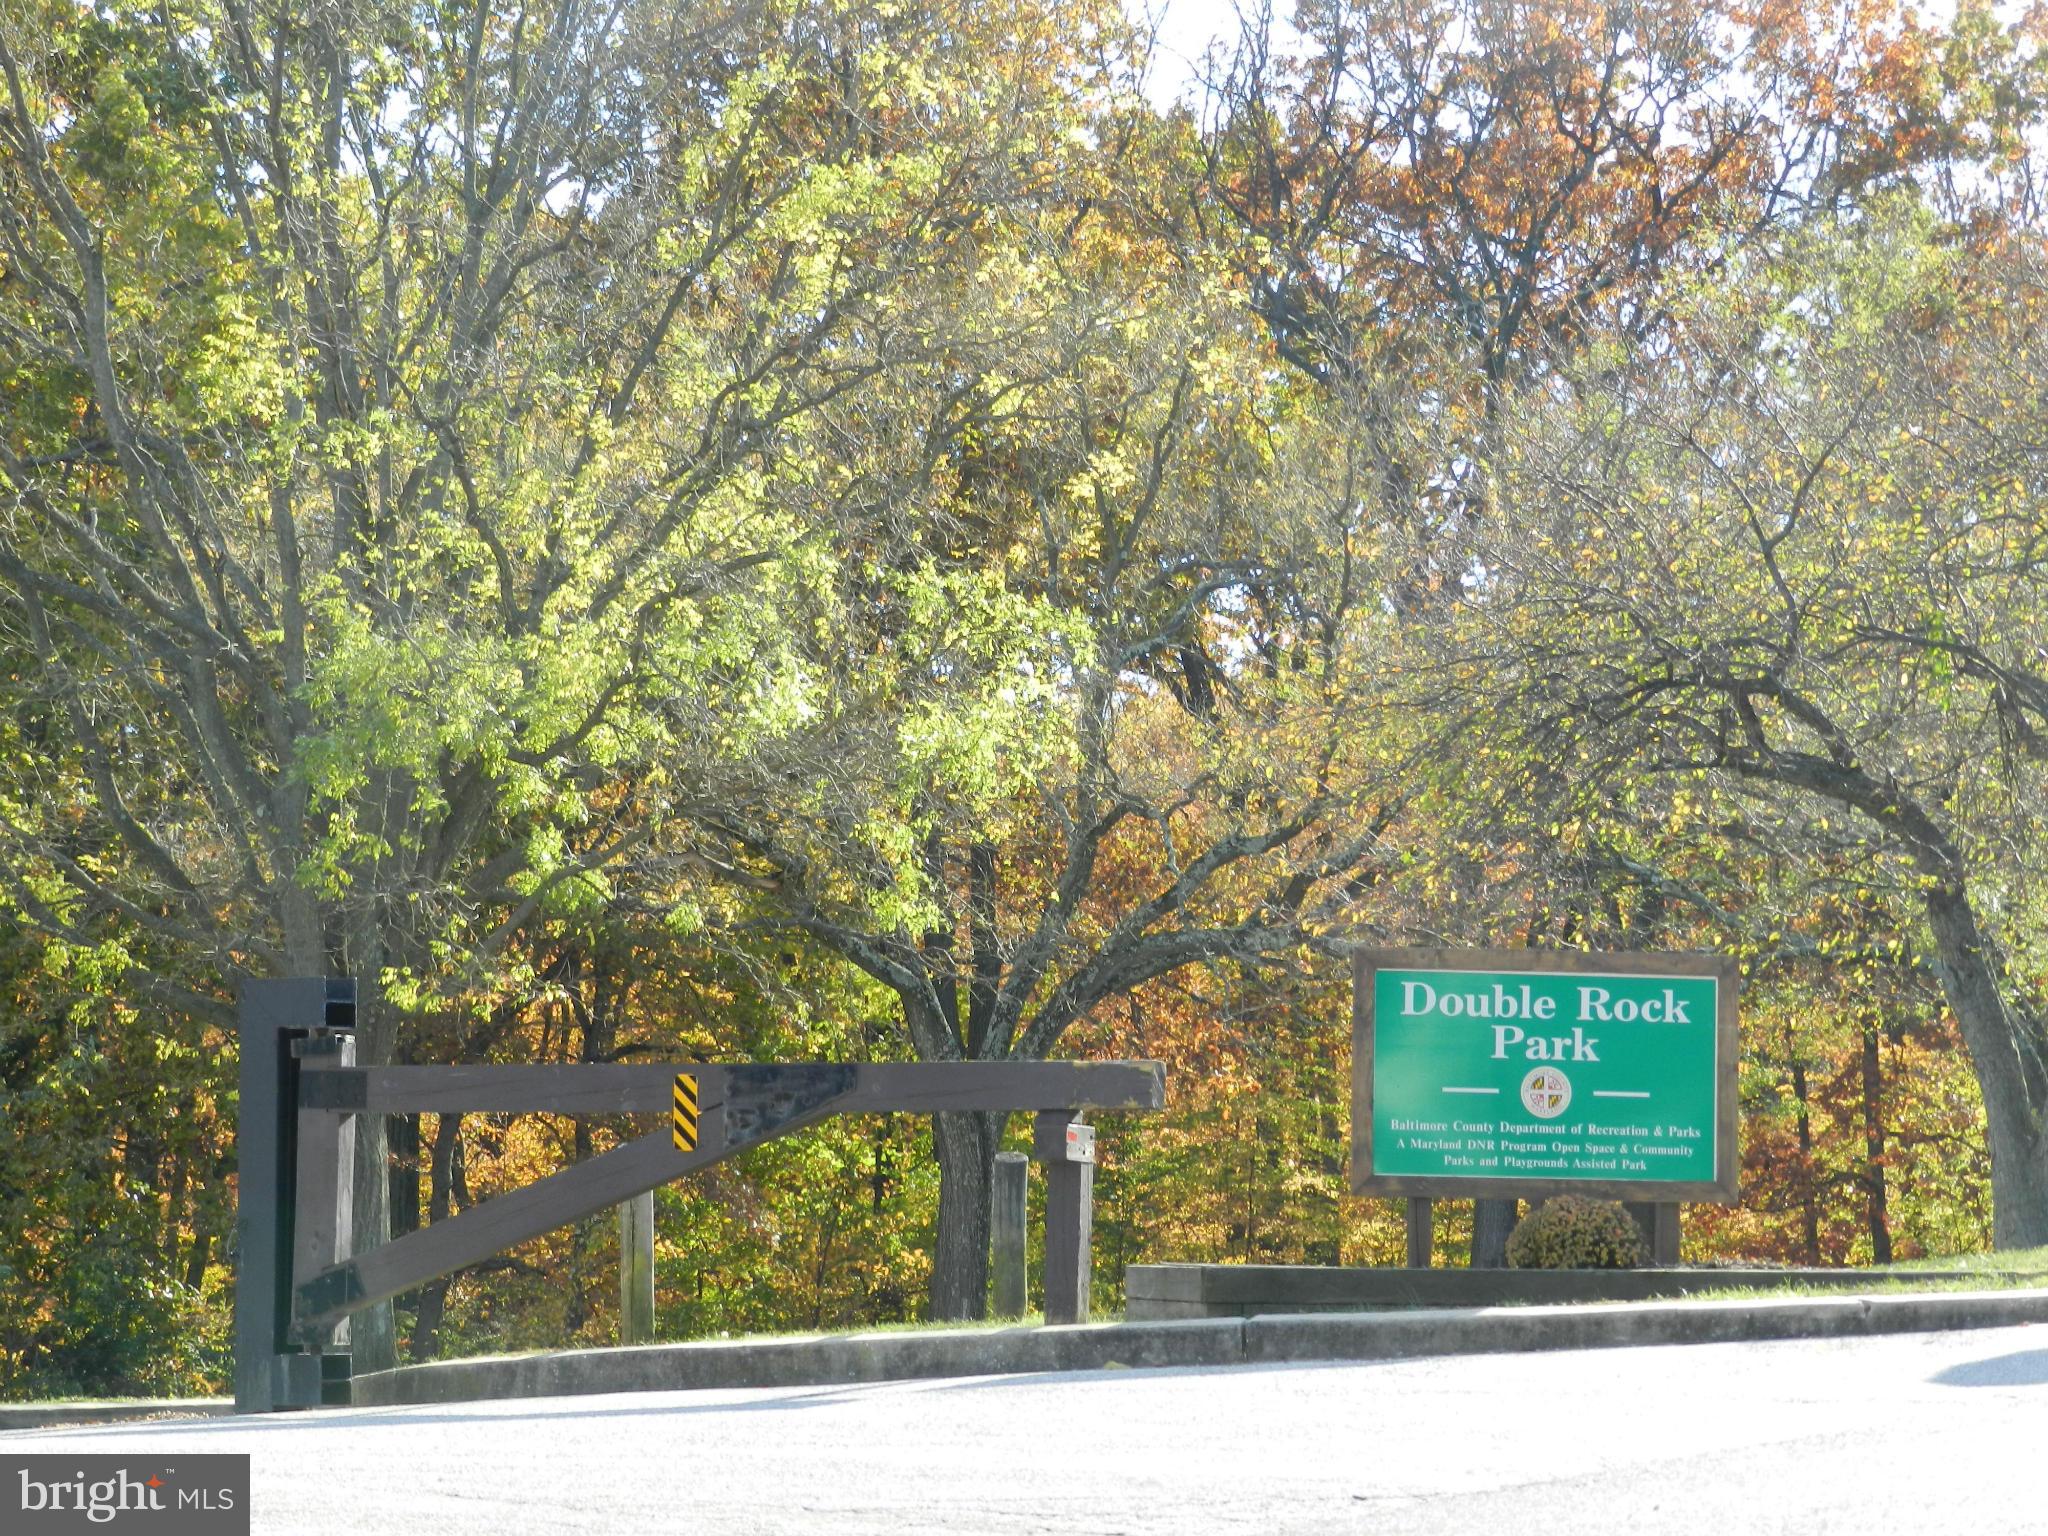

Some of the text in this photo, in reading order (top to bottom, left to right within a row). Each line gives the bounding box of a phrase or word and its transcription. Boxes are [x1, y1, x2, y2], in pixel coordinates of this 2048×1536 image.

[1400, 981, 1691, 1024] Double Rock
[1491, 1025, 1600, 1062] Park
[1391, 1120, 1701, 1137] Baltimore County Department of Recreation & Parks
[1397, 1138, 1693, 1157] A Maryland DNR Program Open Space & Community
[1444, 1156, 1647, 1170] Parks and Playgrounds Assisted Park
